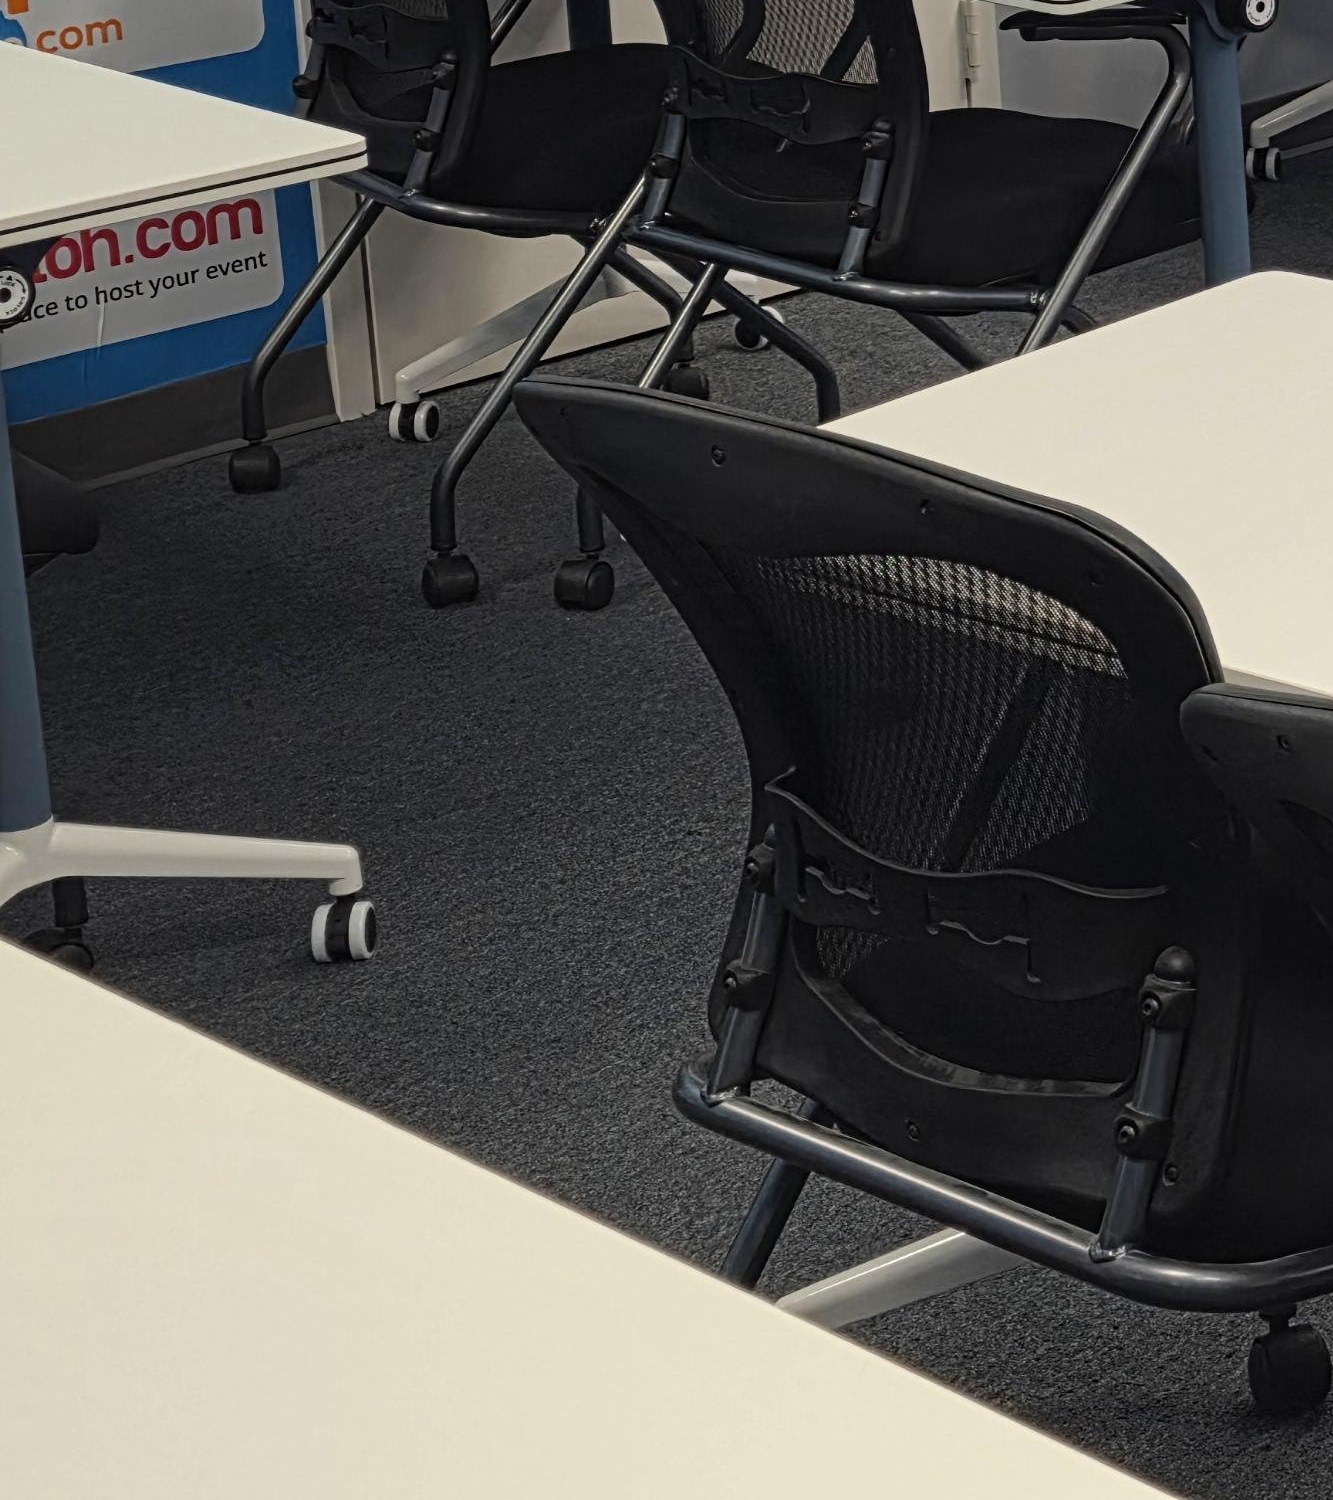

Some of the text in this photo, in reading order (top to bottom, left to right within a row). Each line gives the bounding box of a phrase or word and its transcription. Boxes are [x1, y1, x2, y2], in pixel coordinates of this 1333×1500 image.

[64, 294, 88, 312] to
[94, 279, 145, 306] host
[148, 267, 201, 298] your
[205, 250, 268, 280] event
